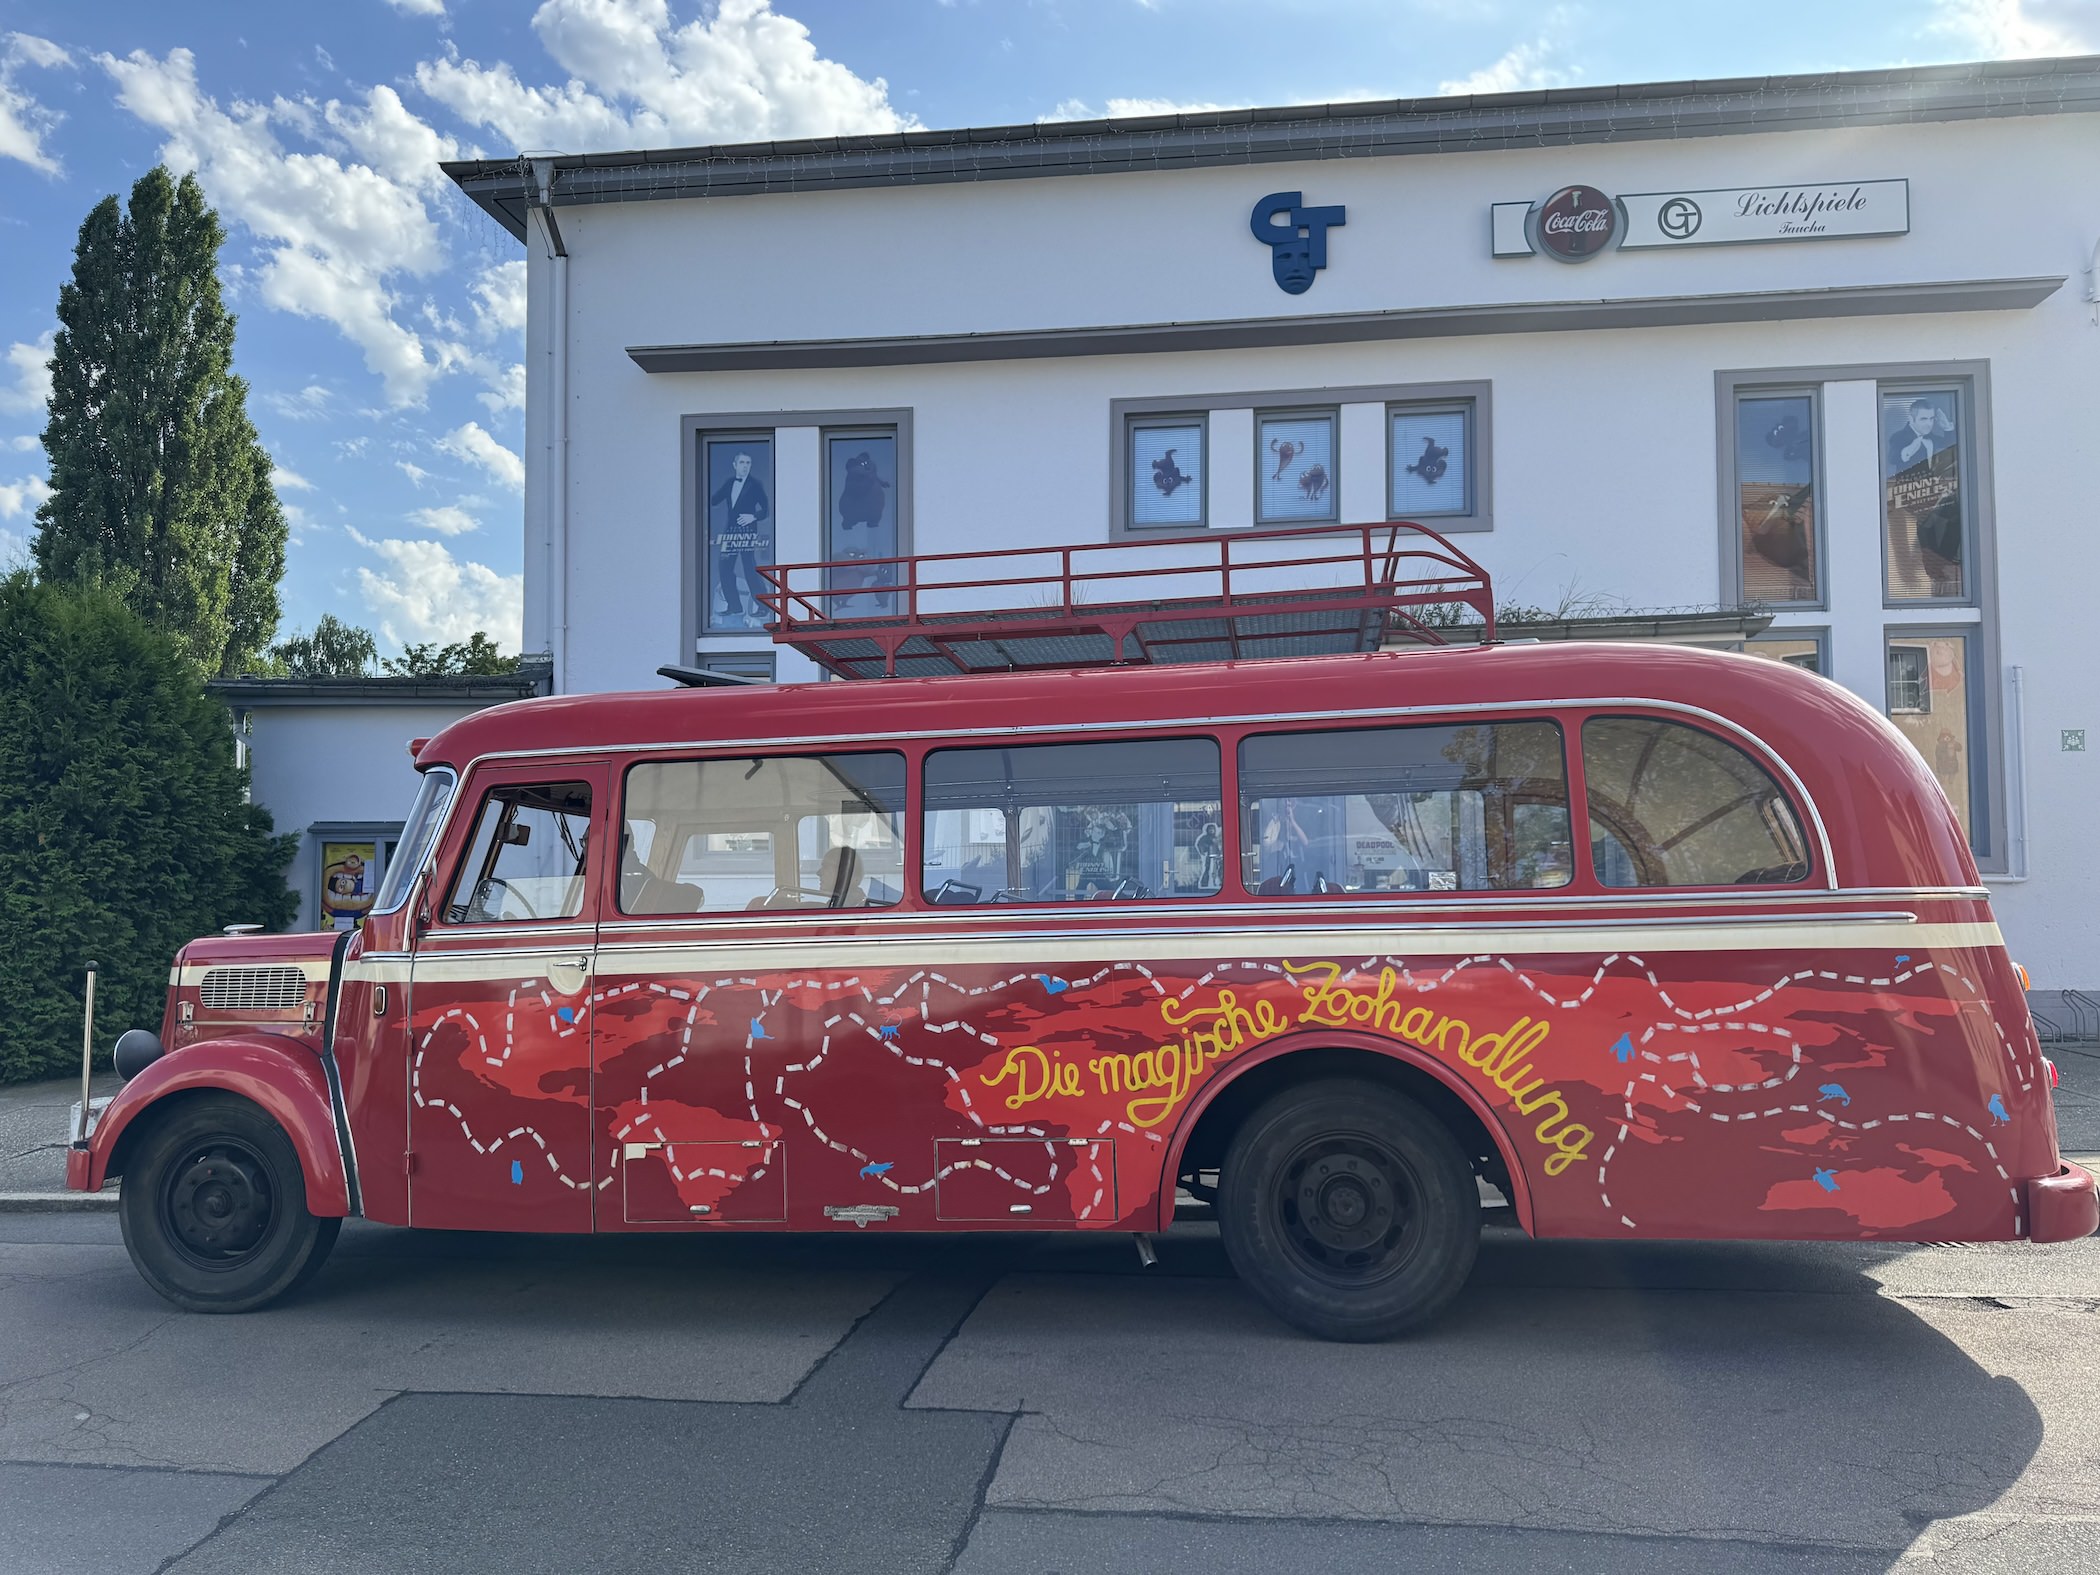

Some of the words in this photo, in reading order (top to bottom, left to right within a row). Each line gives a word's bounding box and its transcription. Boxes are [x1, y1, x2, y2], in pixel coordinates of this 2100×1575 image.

[1734, 187, 1867, 221] Lichtspiele
[1545, 209, 1608, 234] Coca-Cola
[1778, 220, 1826, 234] Taucha
[1356, 841, 1395, 849] DEADPOOL
[980, 1046, 1085, 1110] Die
[1088, 989, 1288, 1127] magische
[1282, 959, 1595, 1176] Zoohandlung
